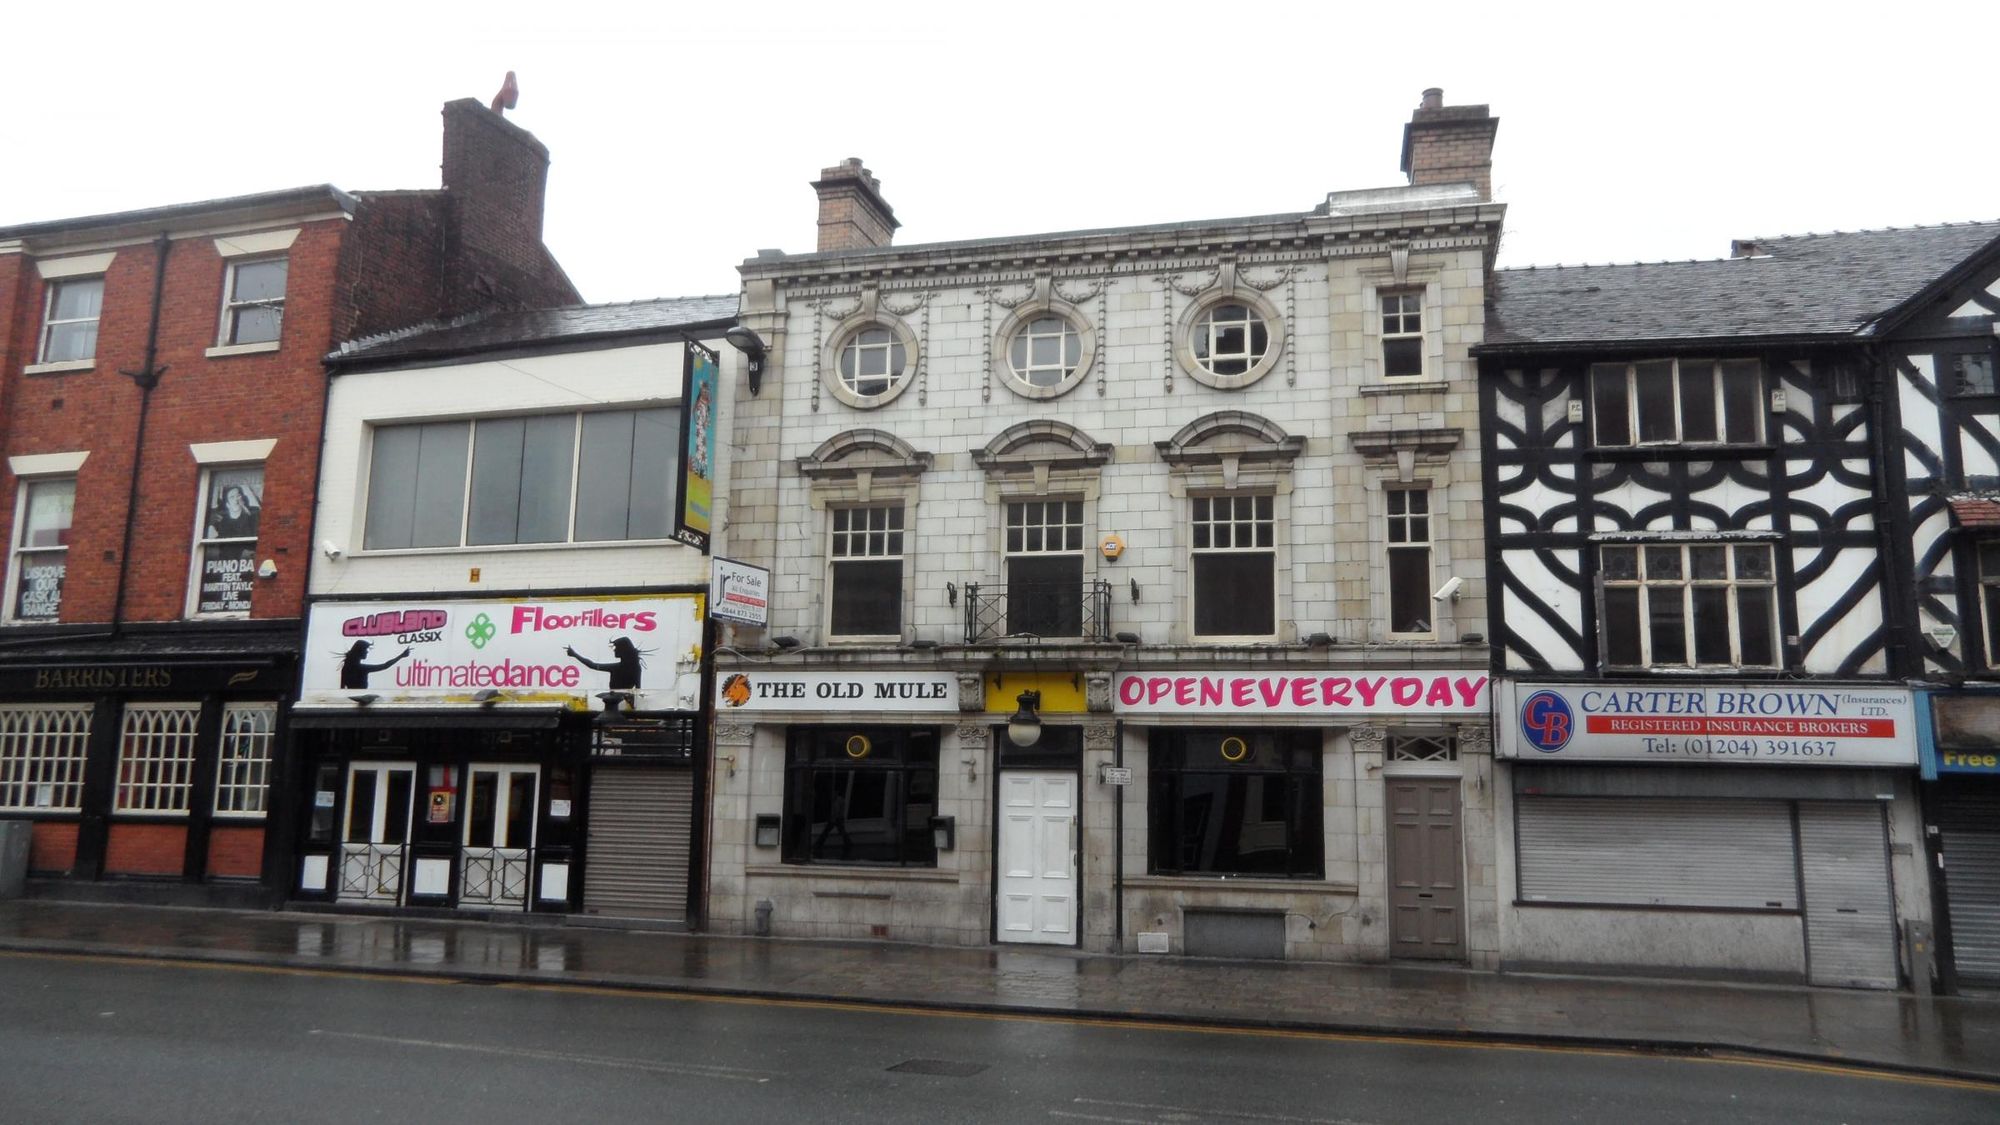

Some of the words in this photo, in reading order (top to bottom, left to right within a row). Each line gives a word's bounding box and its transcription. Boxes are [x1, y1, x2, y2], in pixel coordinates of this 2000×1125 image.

[206, 560, 238, 573] PIANO
[222, 573, 242, 582] FEAT.
[731, 572, 744, 583] For
[746, 575, 762, 587] Sale
[36, 578, 58, 591] OUR
[203, 583, 231, 592] MARTIN
[222, 591, 239, 601] LIVE
[22, 602, 59, 616] RANGE
[201, 602, 225, 611] FRIDAY
[397, 631, 442, 644] CLASSIX
[35, 667, 172, 688] BARRISTERS
[757, 682, 806, 698] THE
[816, 682, 864, 699] OLD
[874, 682, 947, 699] MULE
[1119, 675, 1224, 706] OPEN
[1230, 675, 1387, 707] EVERY
[1390, 676, 1489, 707] DAY
[1581, 691, 1706, 713] CARTER
[1716, 692, 1841, 715] BROWN
[1842, 694, 1907, 705] (Insurances)
[1861, 706, 1889, 716] LTD.
[1611, 719, 1700, 731] REGISTERED
[1706, 720, 1795, 733] INSURANCE
[1800, 721, 1868, 734] BROKERS
[1642, 737, 1676, 754] Tel:
[1684, 738, 1758, 756] (01204)
[1766, 741, 1837, 756] 391637
[1944, 751, 1996, 767] Free
